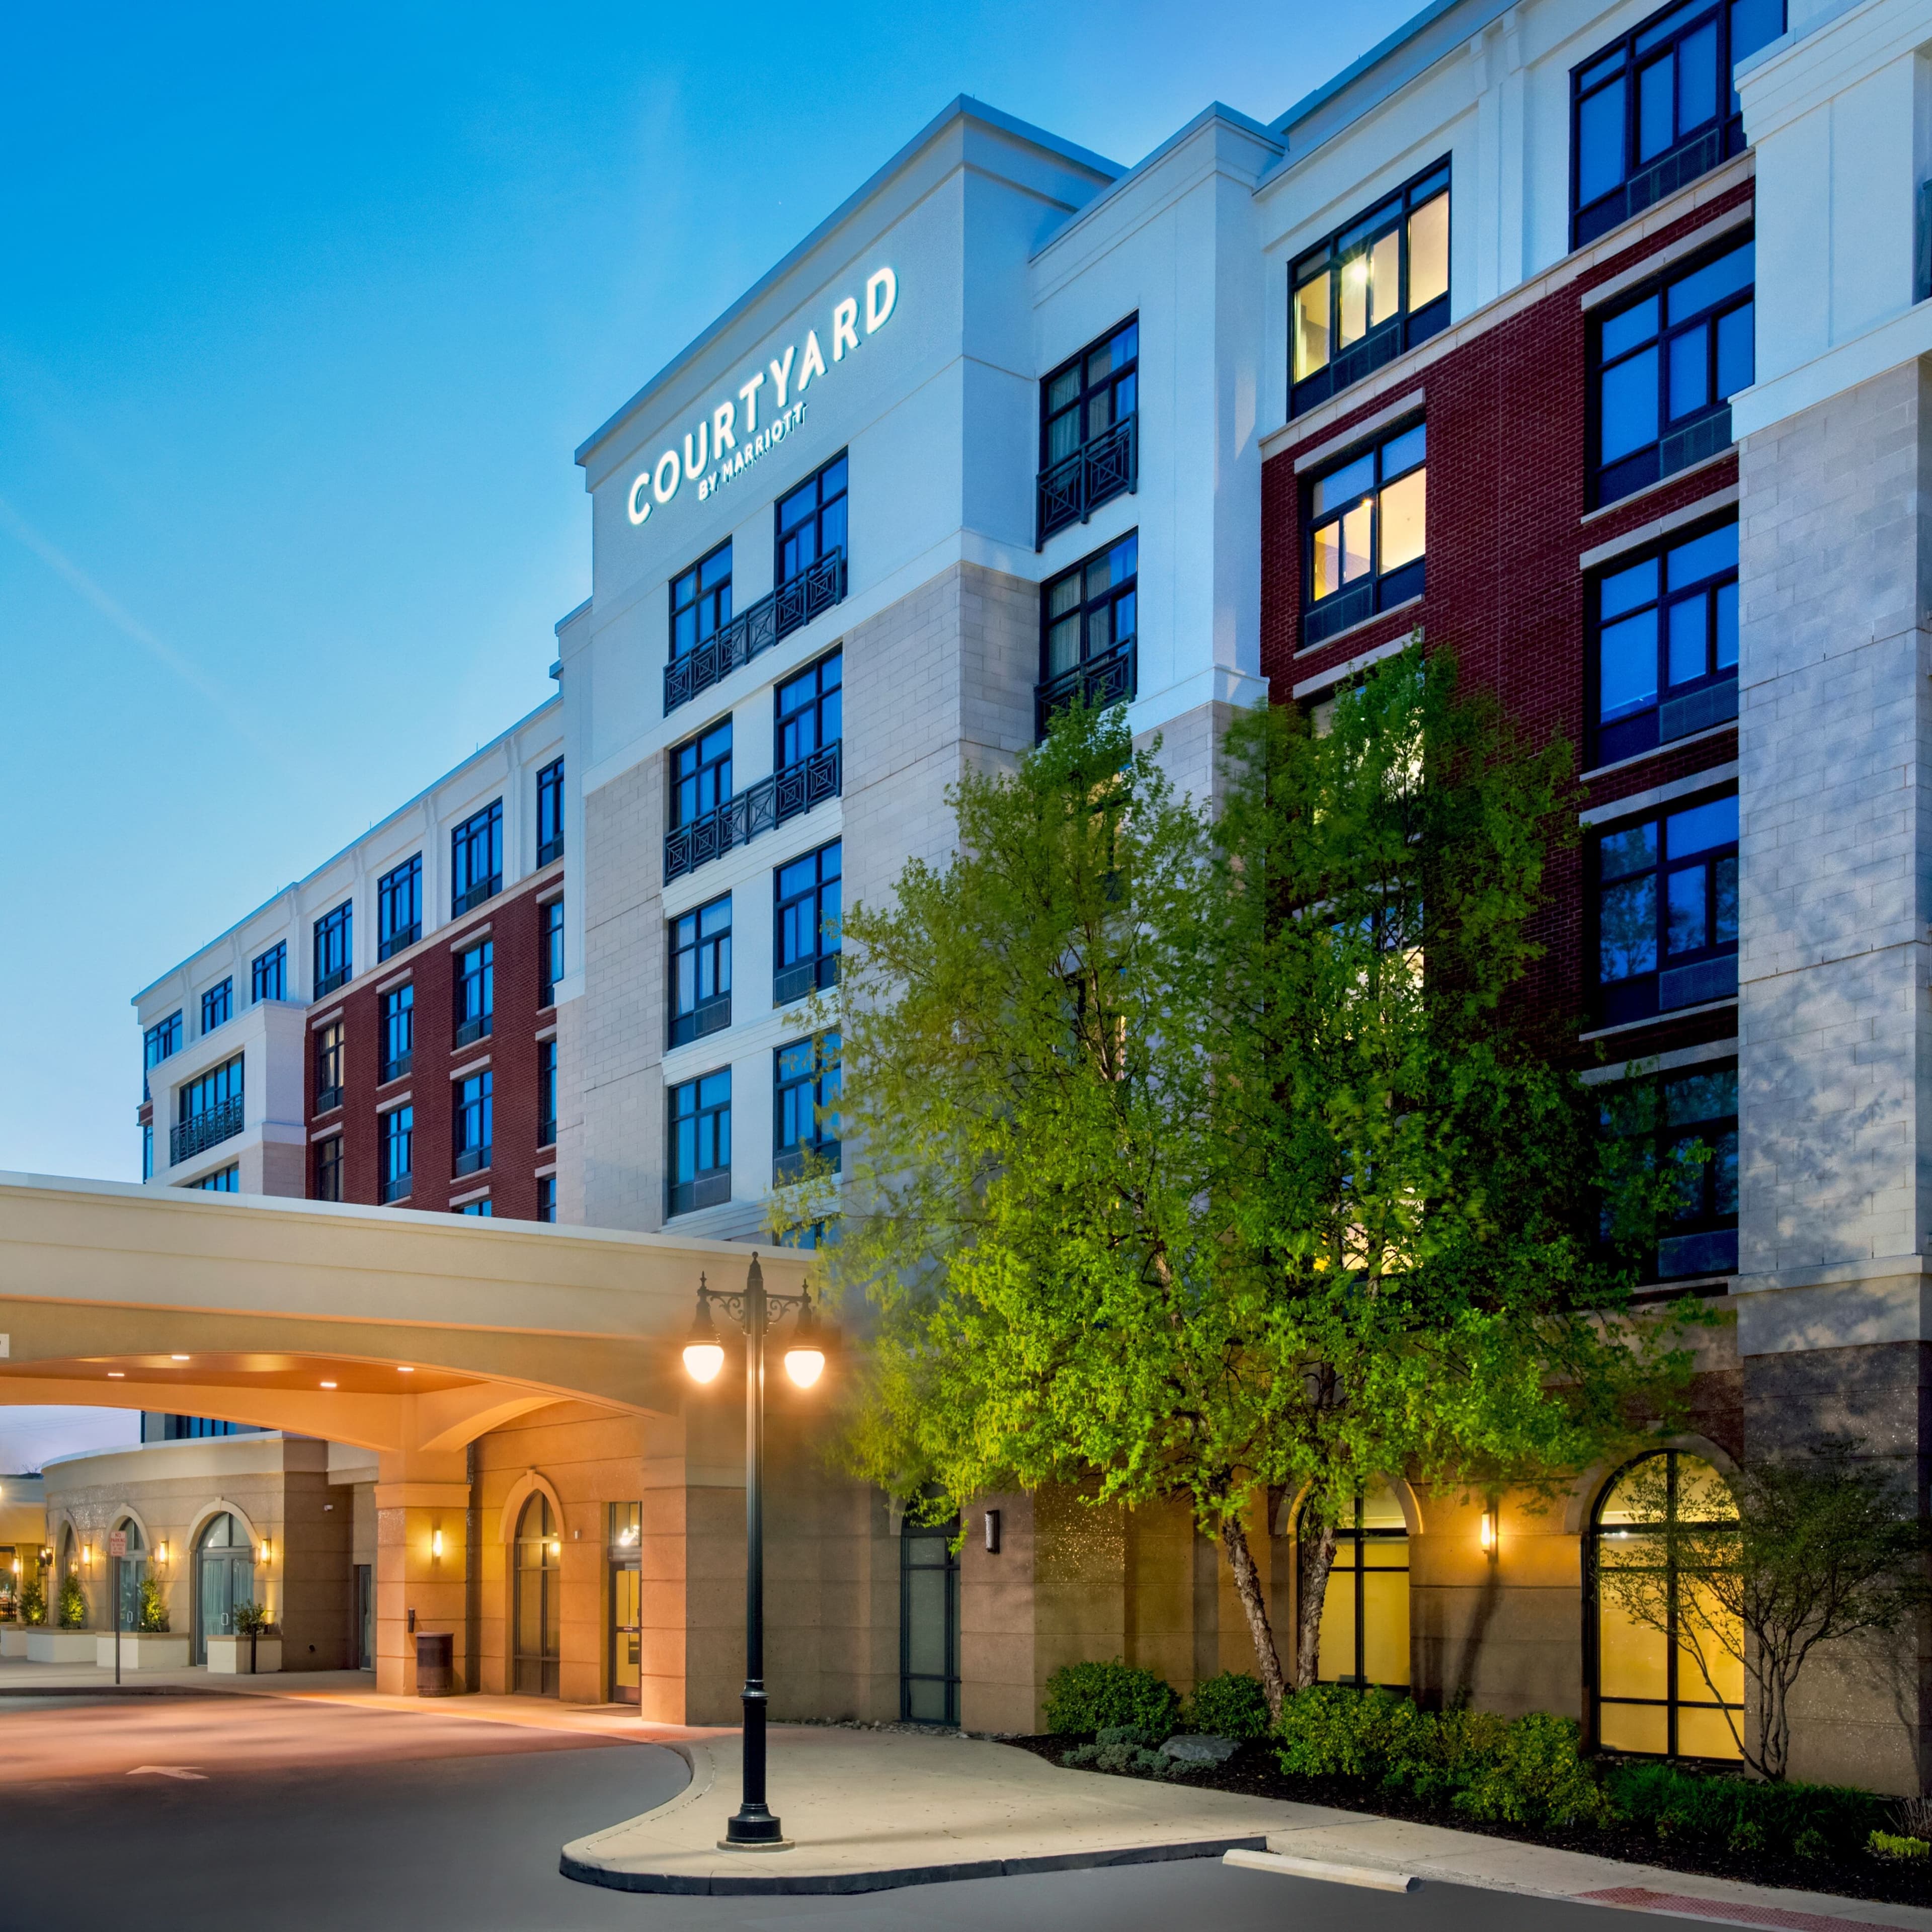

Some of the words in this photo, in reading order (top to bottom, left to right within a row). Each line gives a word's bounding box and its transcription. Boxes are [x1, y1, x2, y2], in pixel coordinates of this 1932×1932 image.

[628, 268, 898, 525] COURTYARD
[698, 471, 719, 501] BY
[722, 401, 807, 482] MARRIOTT
